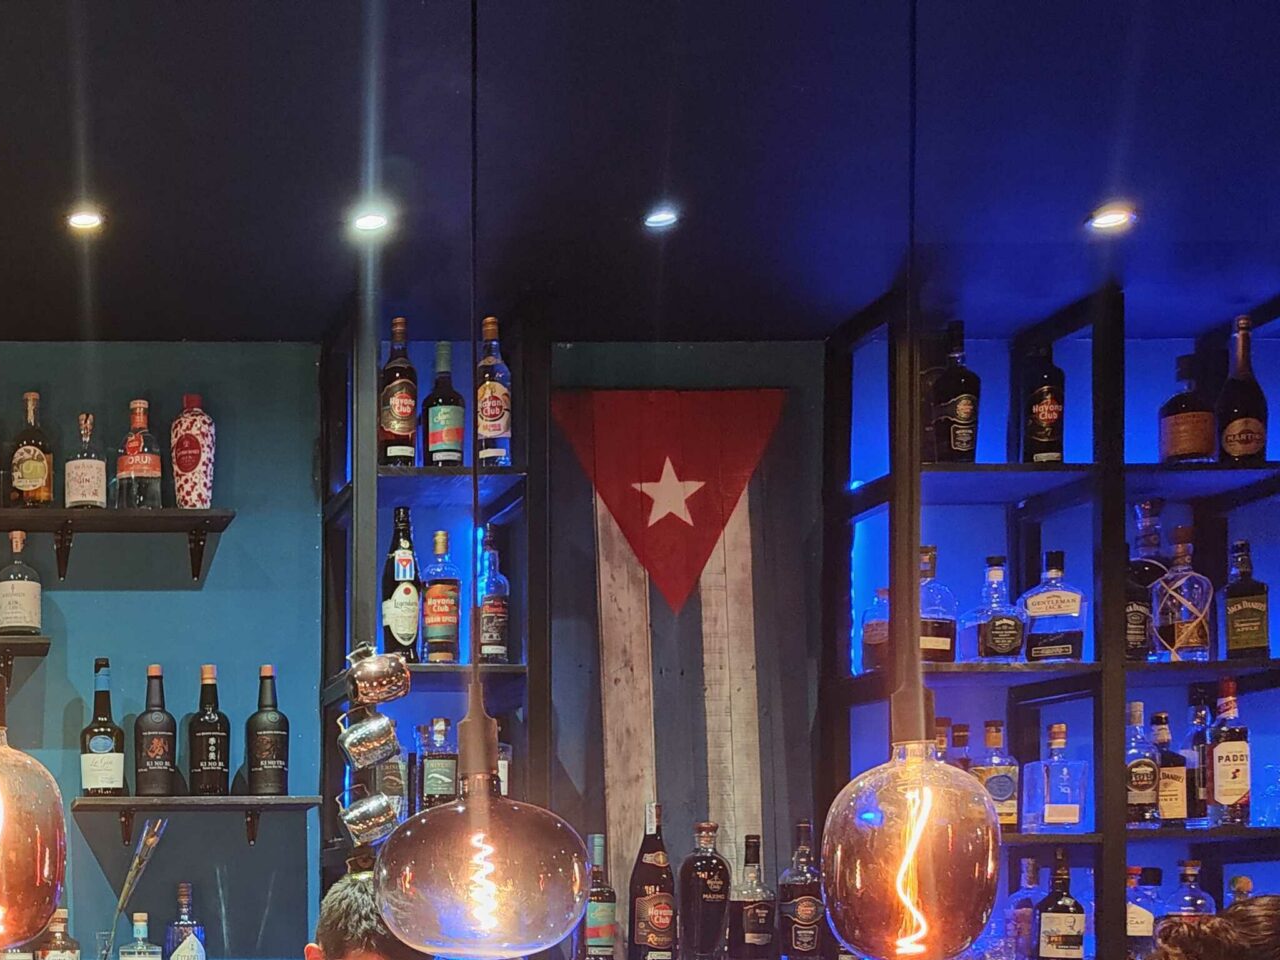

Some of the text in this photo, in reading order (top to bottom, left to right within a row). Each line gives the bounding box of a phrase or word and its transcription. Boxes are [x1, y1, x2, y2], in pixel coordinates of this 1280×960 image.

[395, 404, 412, 413] Club
[1039, 411, 1058, 420] Club
[432, 605, 450, 613] Club
[654, 915, 670, 924] Club
